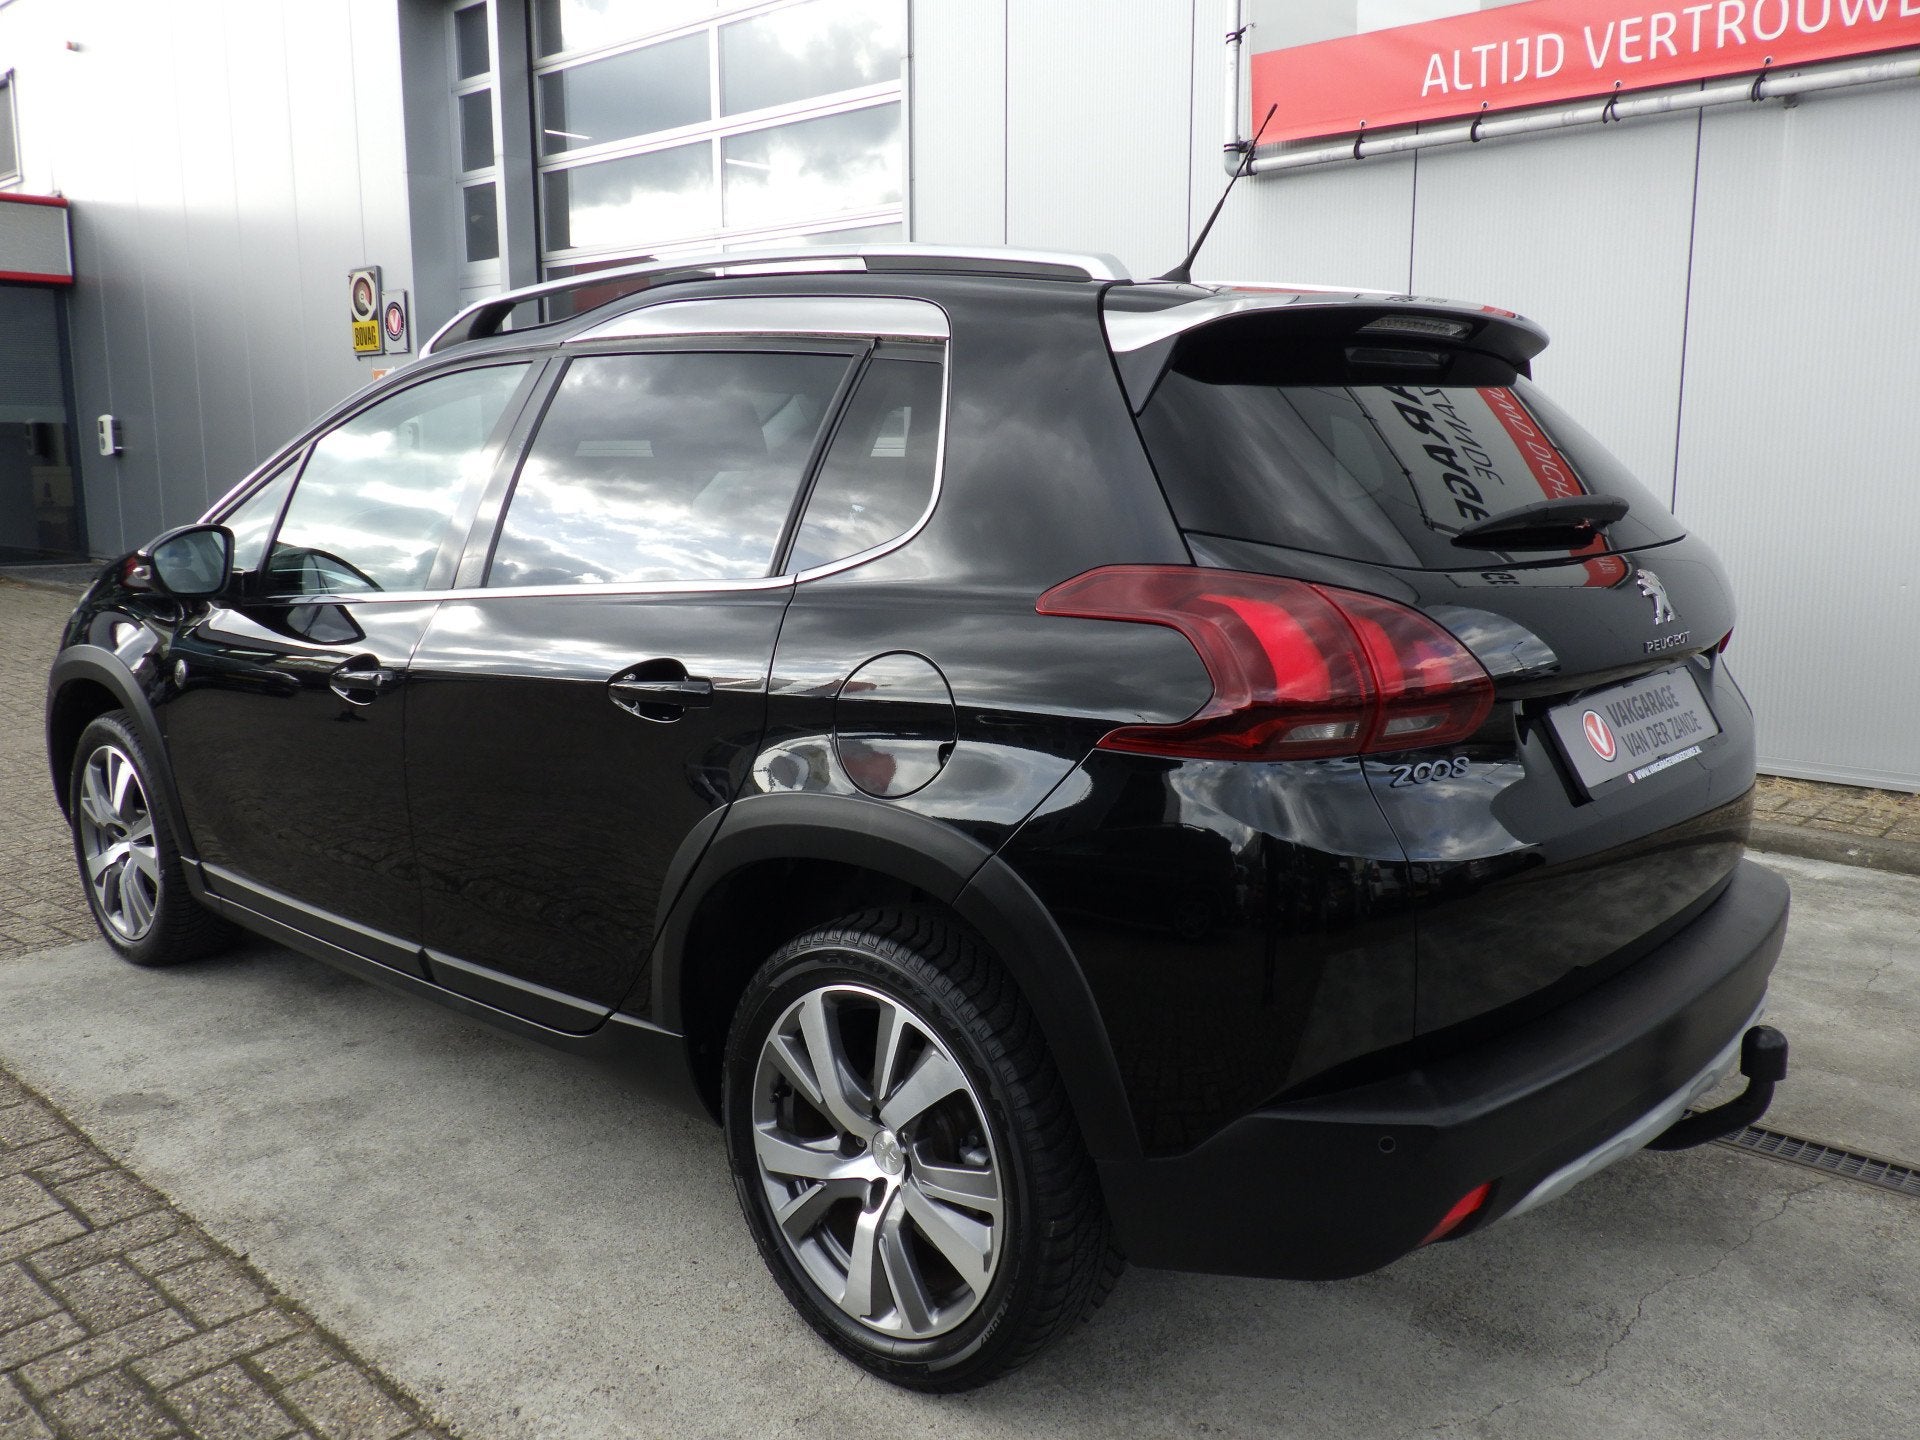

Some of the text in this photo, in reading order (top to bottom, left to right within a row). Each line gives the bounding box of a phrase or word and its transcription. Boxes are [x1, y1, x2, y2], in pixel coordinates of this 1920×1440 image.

[1421, 33, 1564, 97] ALTIJD
[355, 326, 376, 346] BOVAG
[1644, 630, 1691, 654] PEUGEOT
[1605, 685, 1680, 729] VAKGARAGE
[1621, 710, 1703, 758] VAN DER ZANDE
[1392, 756, 1471, 788] 2008
